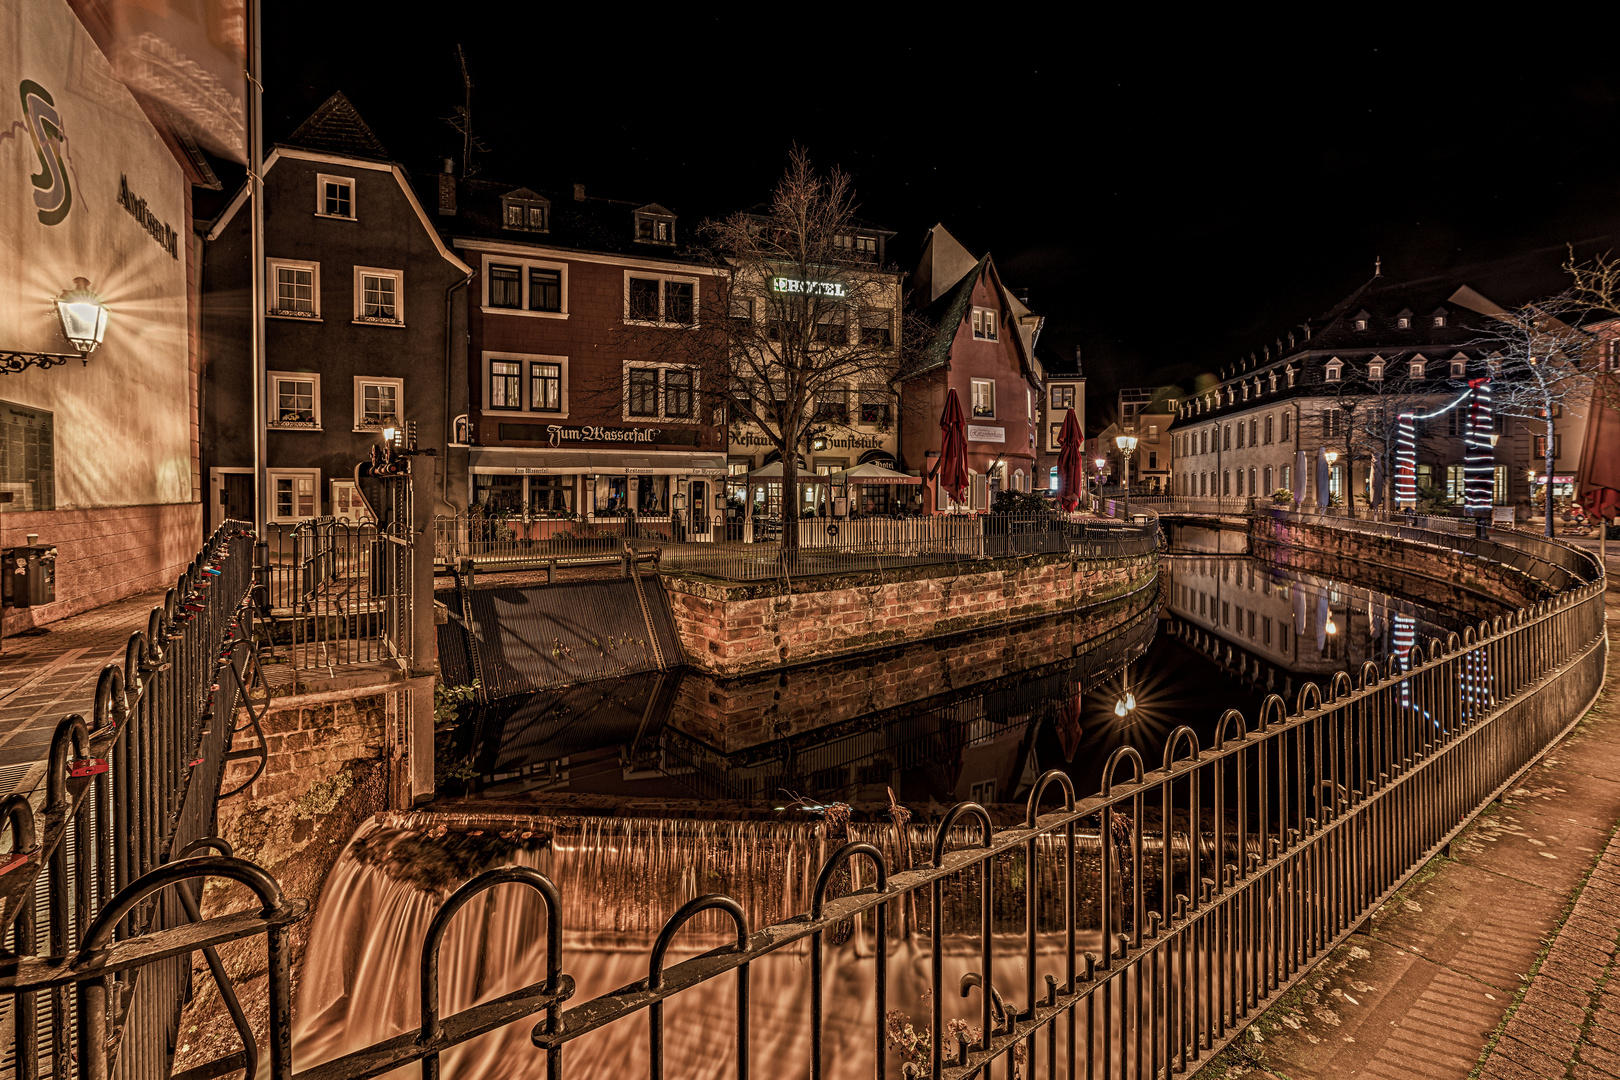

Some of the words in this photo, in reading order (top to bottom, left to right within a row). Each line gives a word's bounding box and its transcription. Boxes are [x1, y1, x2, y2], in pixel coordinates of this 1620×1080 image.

[546, 424, 582, 448] Zum
[582, 425, 661, 444] Wasserfall
[728, 430, 775, 447] Restaur
[825, 433, 883, 450] Zunftstube
